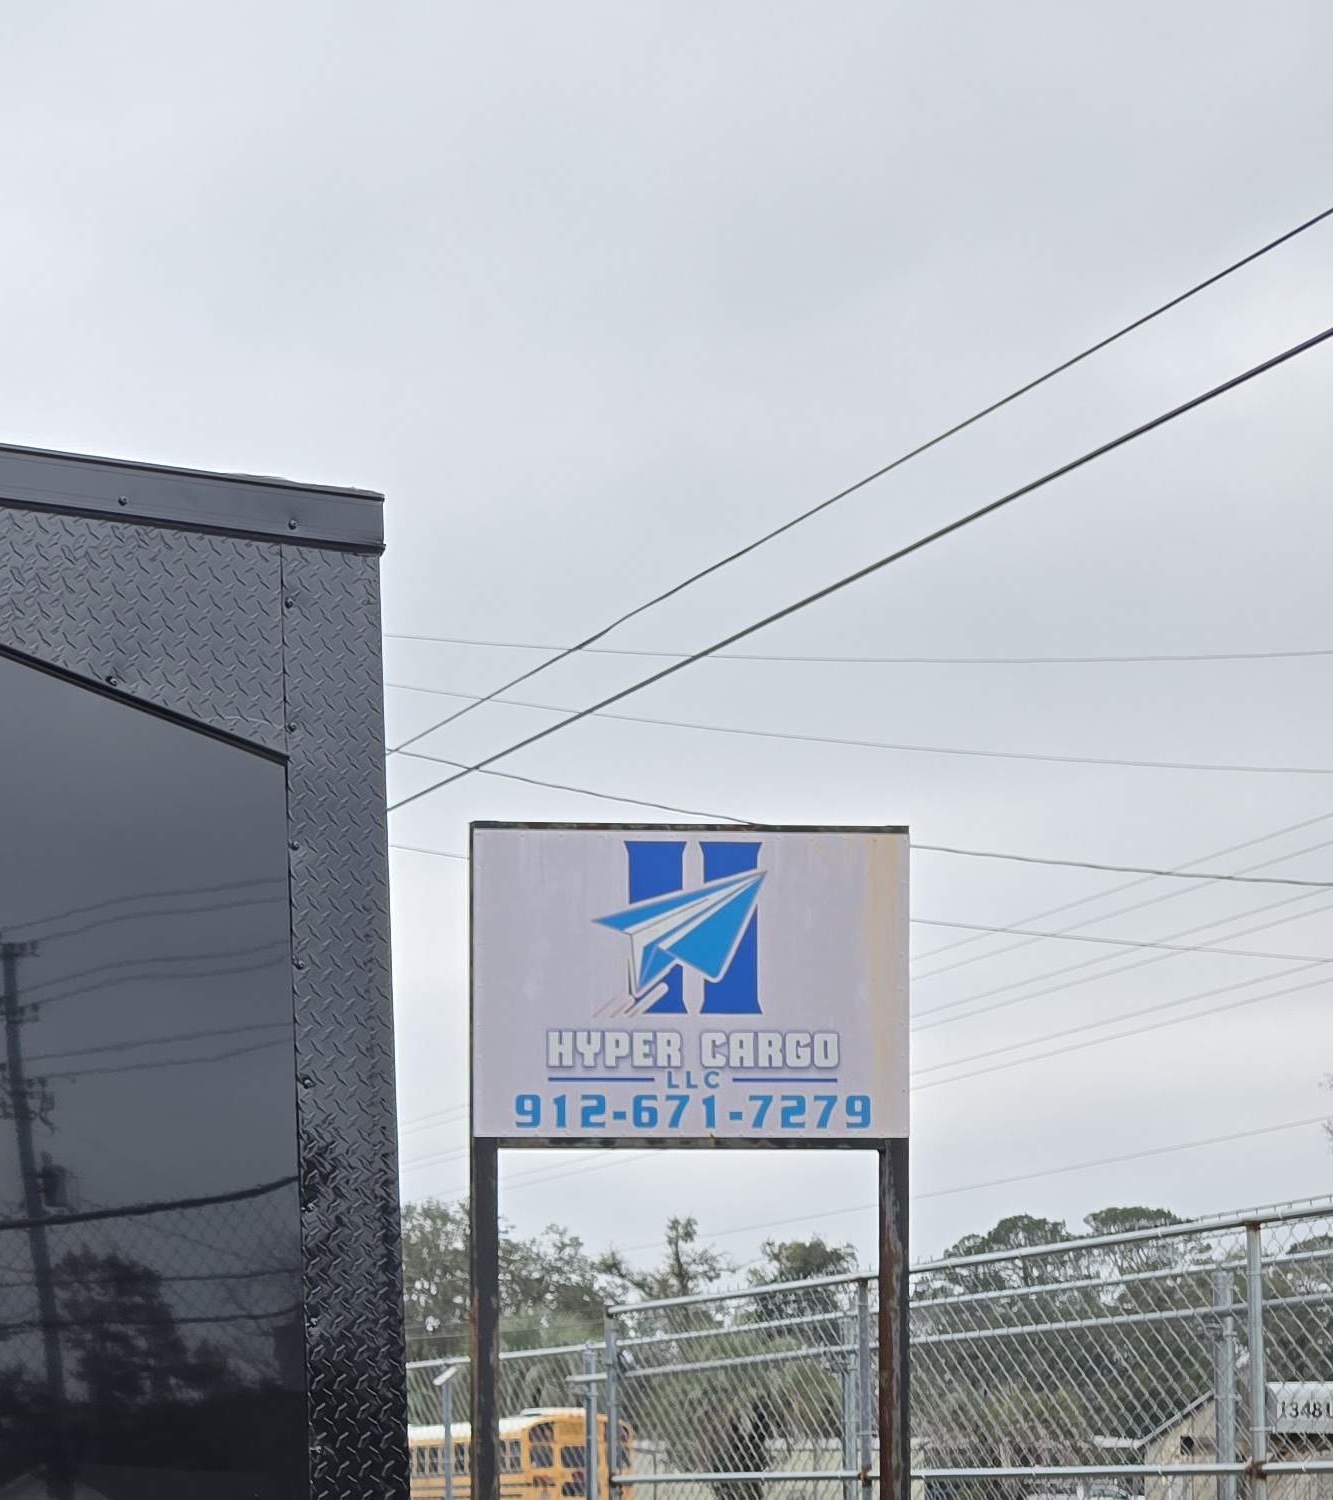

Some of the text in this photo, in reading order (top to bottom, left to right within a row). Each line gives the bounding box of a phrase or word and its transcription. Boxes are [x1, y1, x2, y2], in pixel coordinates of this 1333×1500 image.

[545, 1028, 840, 1070] HYPER CARGO
[666, 1071, 721, 1089] LLC
[514, 1093, 872, 1130] 912-671-7279
